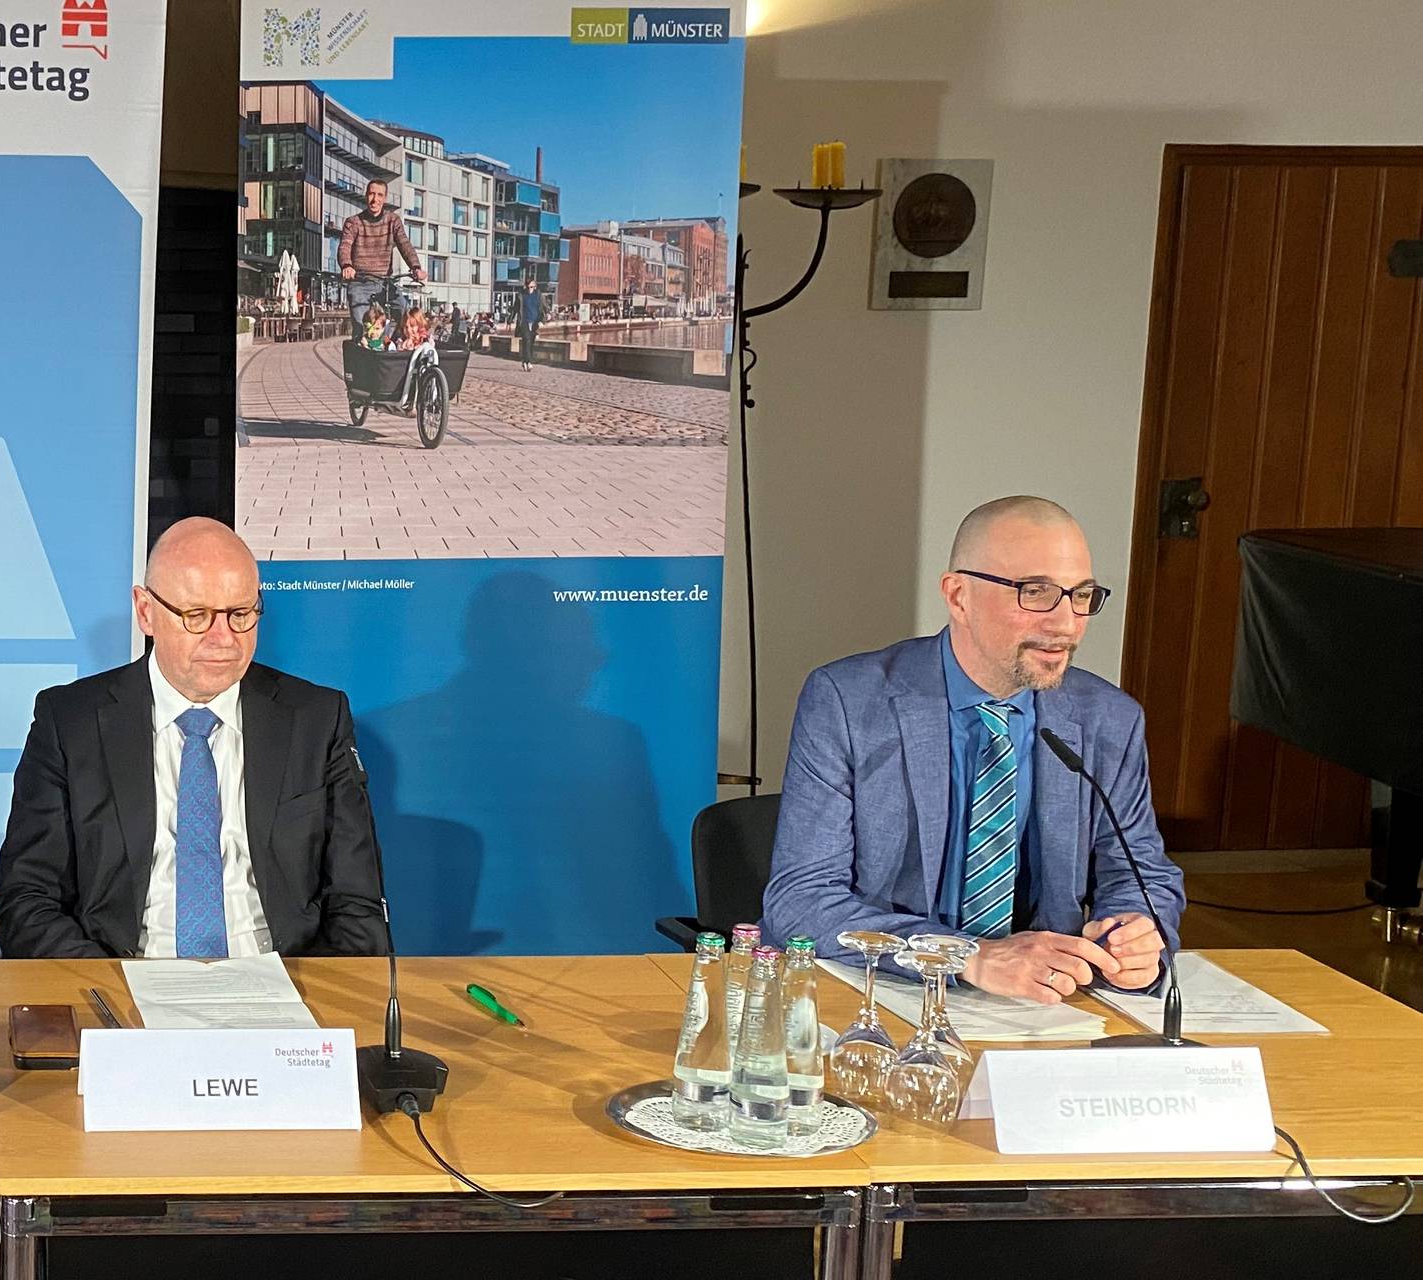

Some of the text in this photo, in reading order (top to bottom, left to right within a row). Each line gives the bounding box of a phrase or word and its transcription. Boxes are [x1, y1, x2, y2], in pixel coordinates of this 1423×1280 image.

[577, 20, 723, 38] STADT MÜNSTER
[259, 580, 276, 590] oto:
[277, 580, 302, 591] Stadt
[303, 580, 341, 590] Münster
[347, 579, 383, 589] Michael
[384, 578, 415, 589] Möller
[553, 584, 708, 601] www.muenster.de
[275, 1047, 320, 1058] Deutscher
[287, 1057, 331, 1068] Städtetag
[192, 1078, 259, 1097] LEWE
[1058, 1096, 1198, 1119] STEINBORN
